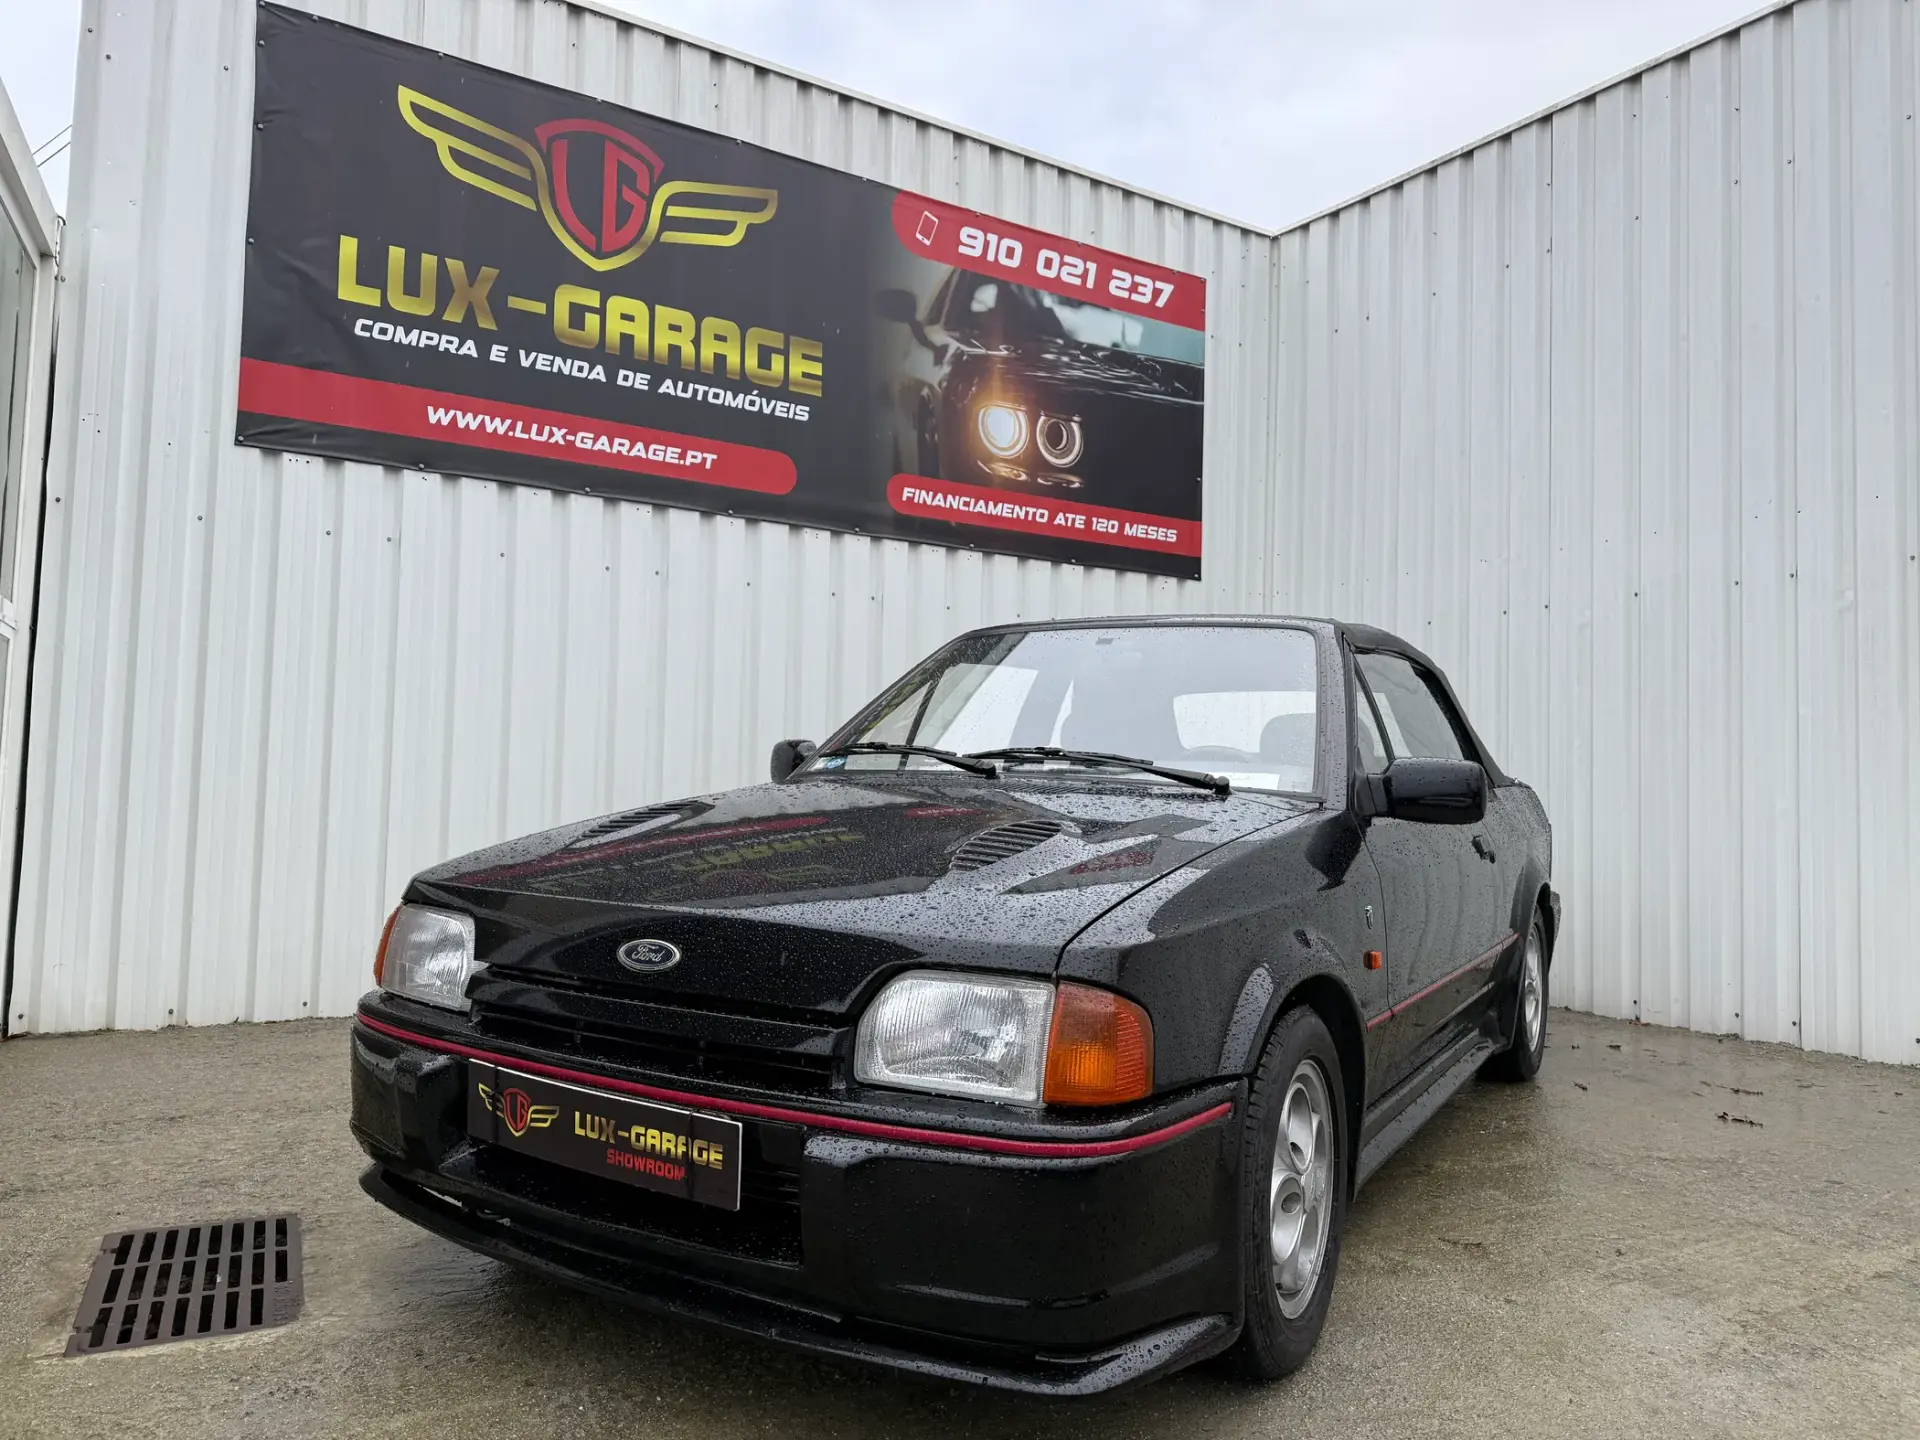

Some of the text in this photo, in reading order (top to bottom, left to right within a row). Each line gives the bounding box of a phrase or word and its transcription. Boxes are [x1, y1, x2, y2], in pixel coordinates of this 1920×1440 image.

[957, 226, 1175, 308] 910 021 237
[337, 234, 824, 398] LUX-GARAGE
[354, 318, 810, 422] COMPRA E VENDA DE AUTOMÓVEIS
[427, 405, 718, 470] WWW.LUX-GARAGE.PT
[902, 487, 1178, 542] FINANCIAMENTO ATE 120 MESES
[631, 943, 666, 962] Ford
[574, 1110, 724, 1170] LUX-GARAGE
[606, 1147, 686, 1181] SHOWROOM
